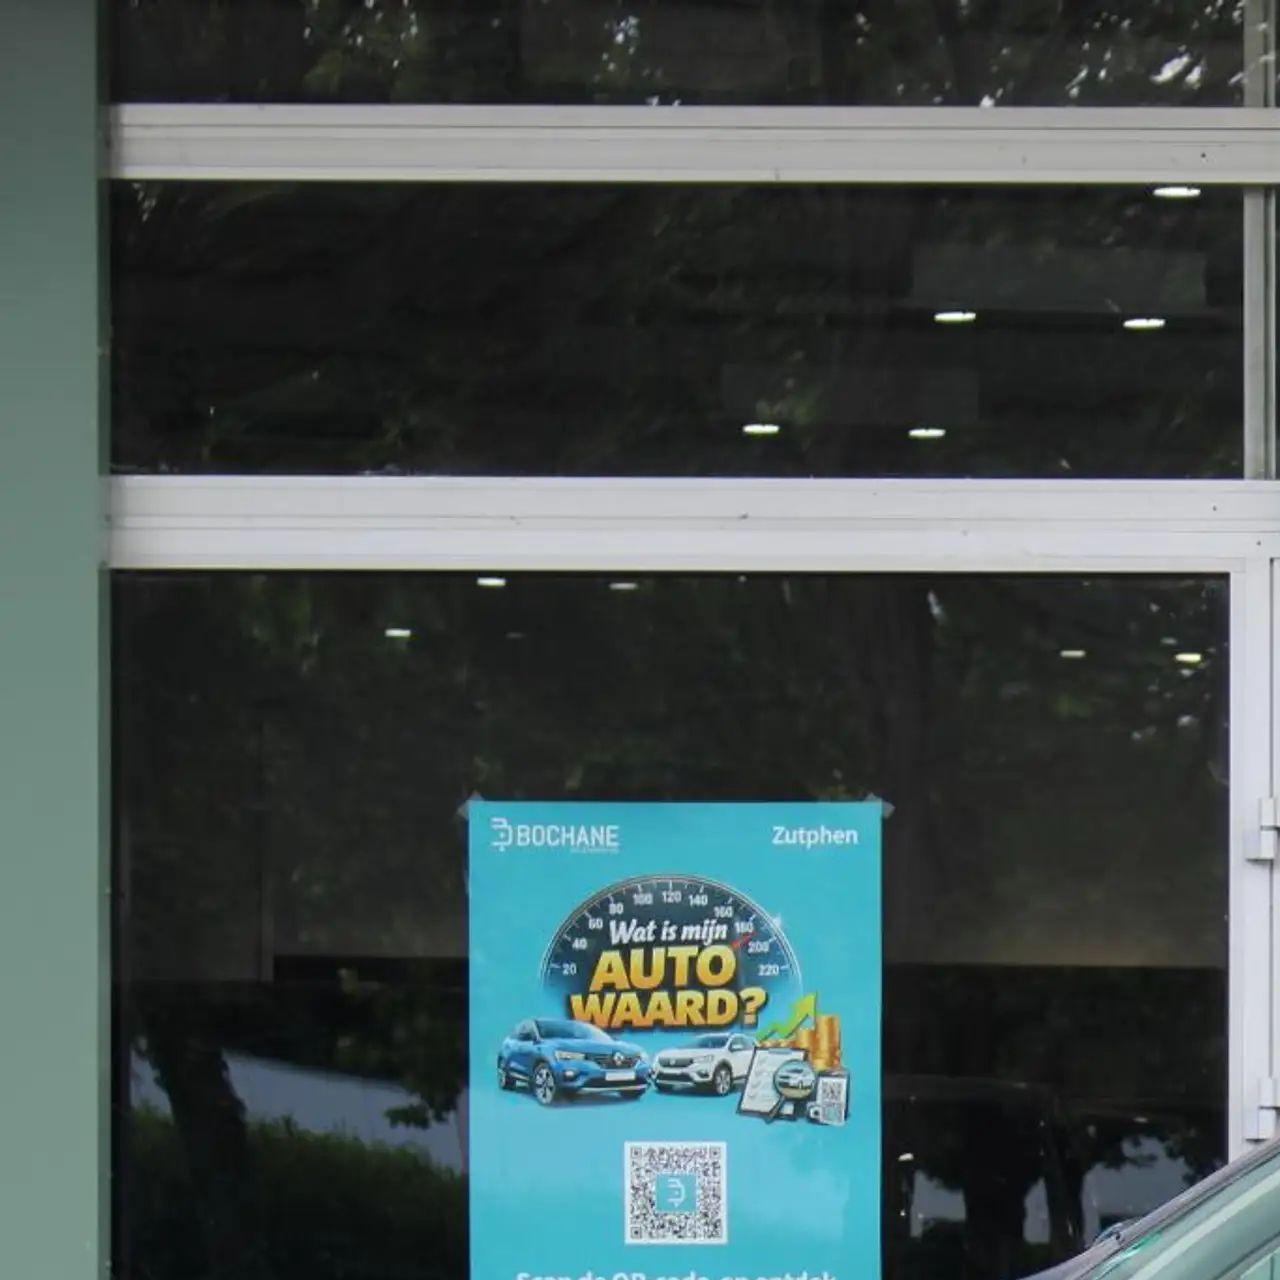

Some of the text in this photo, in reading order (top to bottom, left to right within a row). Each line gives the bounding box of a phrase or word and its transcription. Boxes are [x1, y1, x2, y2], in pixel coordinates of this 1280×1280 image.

[517, 825, 620, 847] BOCHANE
[772, 825, 859, 850] Zutphen
[562, 963, 577, 975] 20
[572, 938, 588, 949] 40
[662, 890, 682, 903] 120
[688, 894, 708, 906] 140
[609, 919, 728, 946] Wat is mijn
[591, 945, 737, 991] AUTO
[570, 988, 768, 1027] WAARD?
